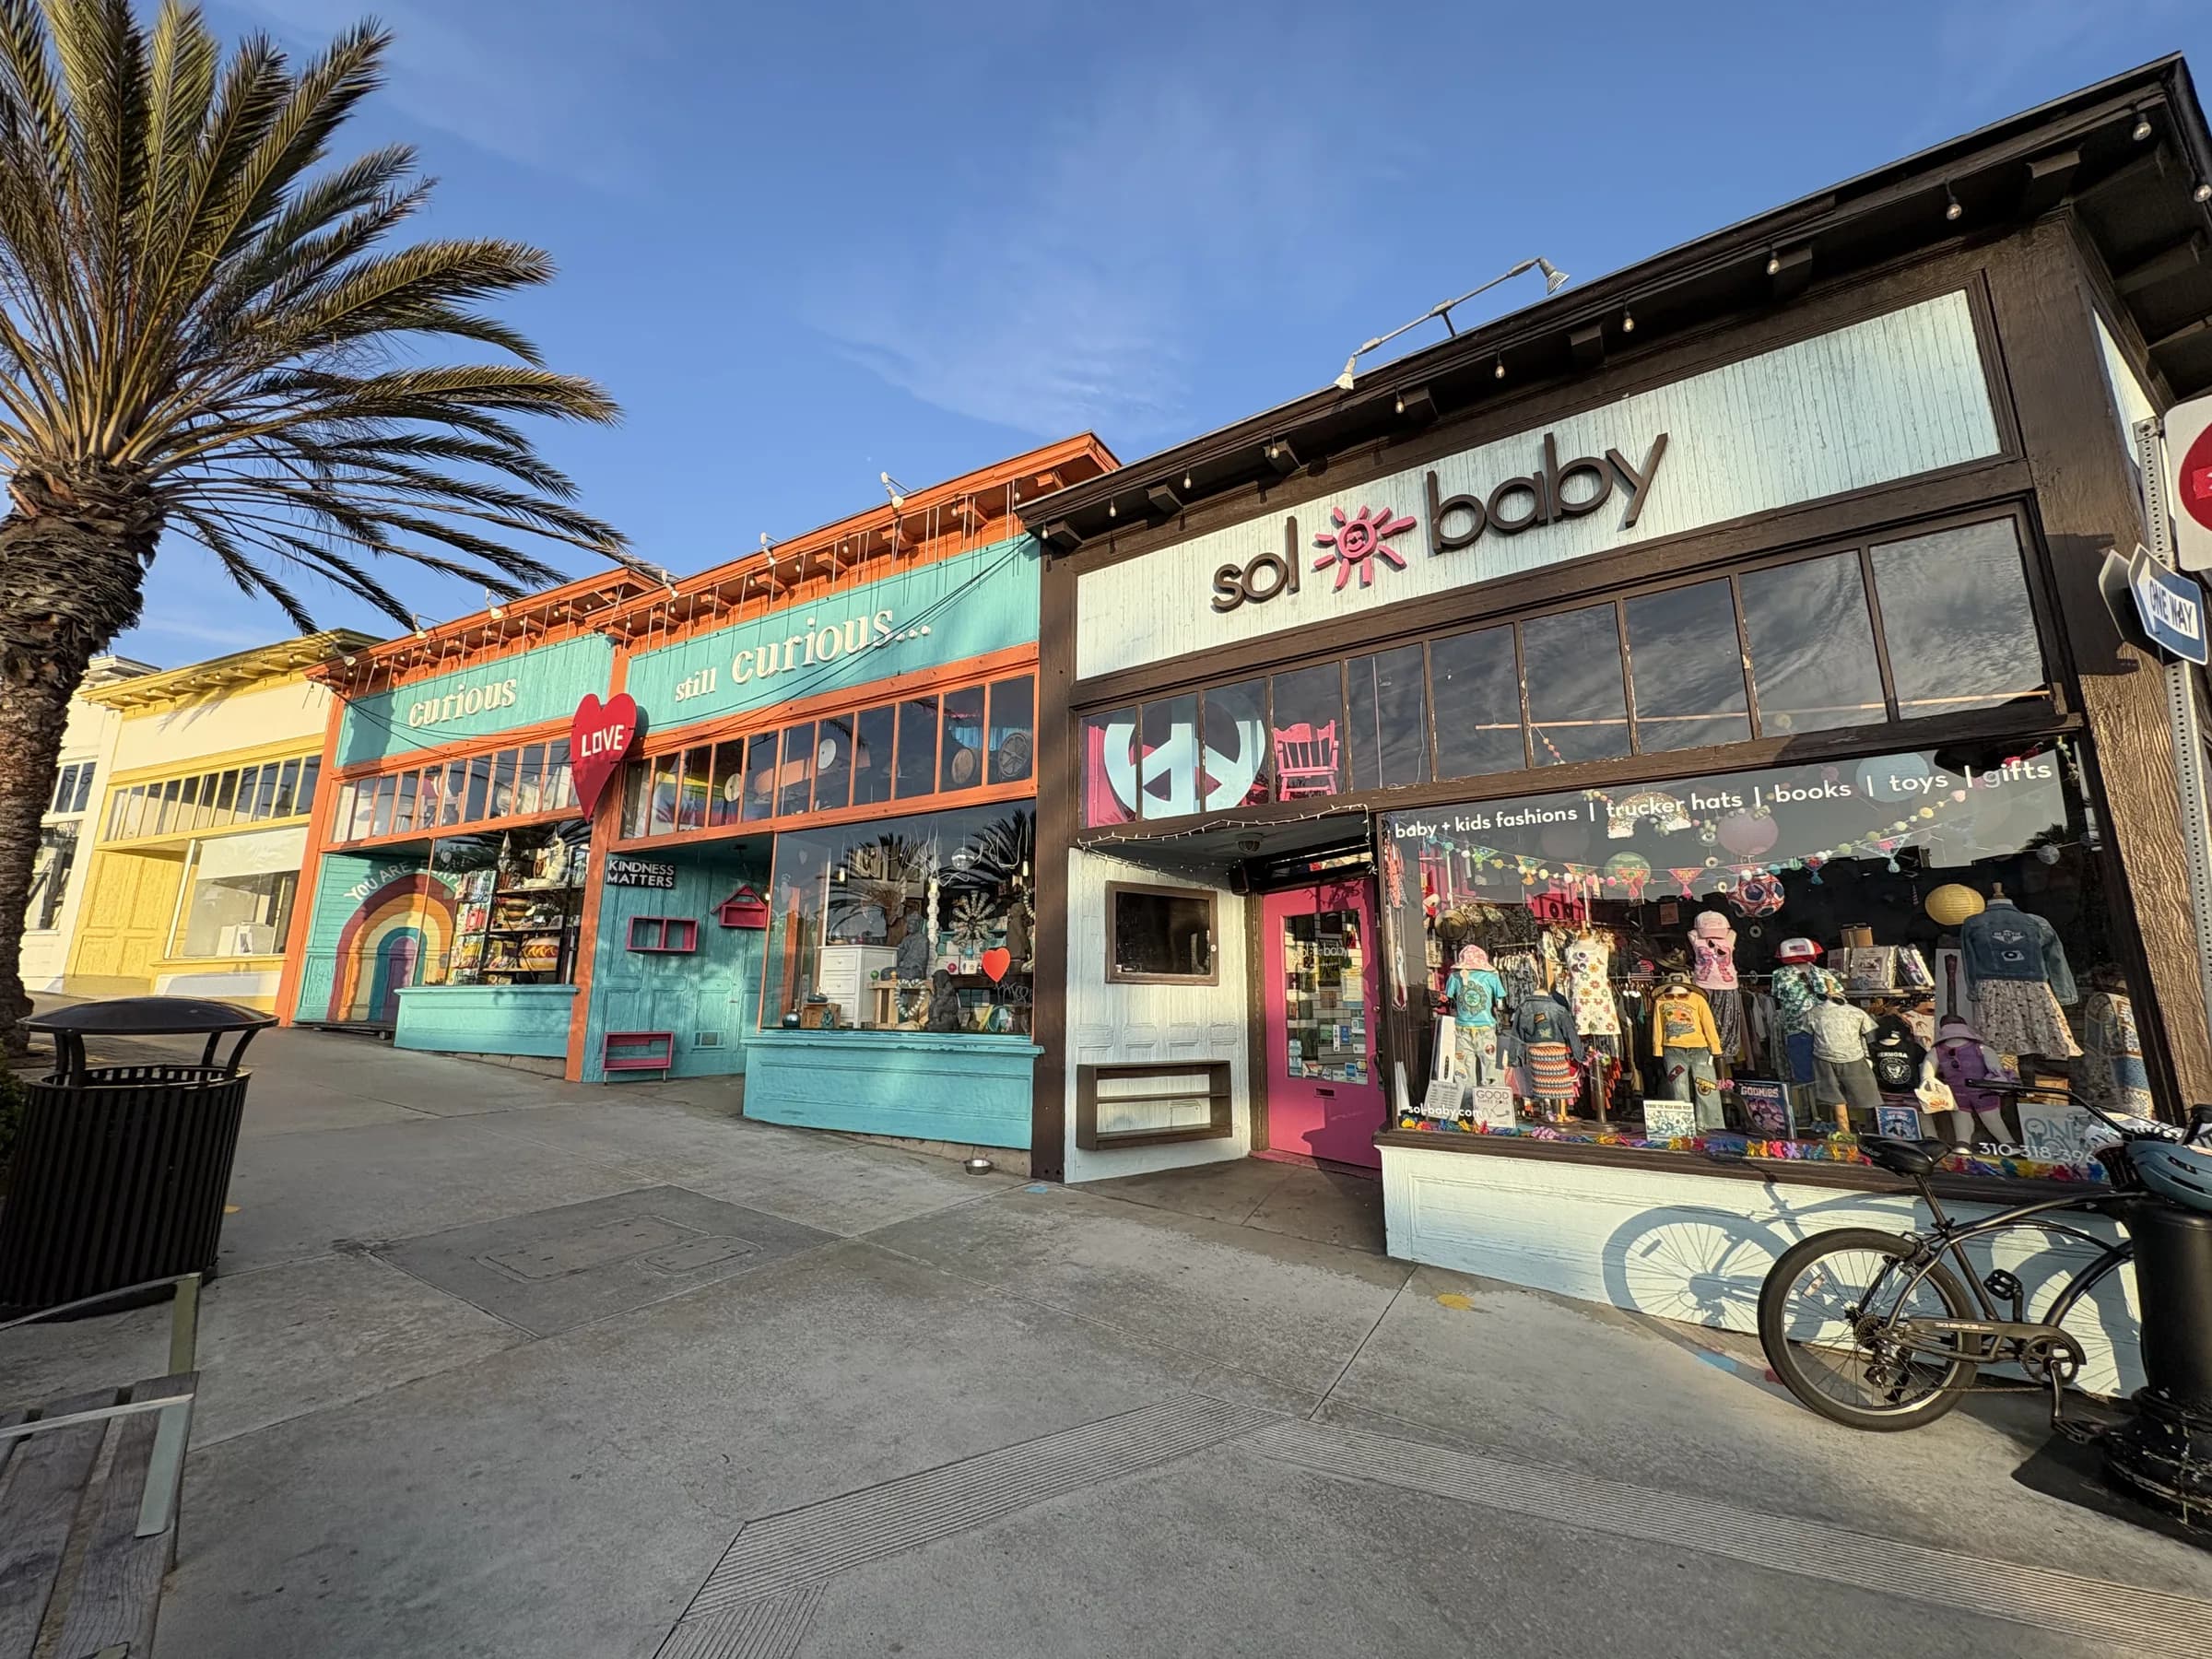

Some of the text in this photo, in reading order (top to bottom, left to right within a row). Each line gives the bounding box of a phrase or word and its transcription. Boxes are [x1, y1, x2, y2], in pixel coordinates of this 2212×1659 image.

[1211, 431, 1668, 611] sol baby
[2149, 580, 2193, 633] ONE WAY
[675, 666, 717, 702] still
[408, 678, 517, 727] curious
[581, 724, 625, 758] LOVE
[1394, 820, 1438, 839] baby
[1454, 815, 1491, 832] kids
[1495, 806, 1578, 828] fashions
[1606, 796, 1685, 818] trucker
[1690, 792, 1743, 811] hats
[1774, 780, 1851, 803] books
[1888, 773, 1949, 794] toys
[1983, 760, 2053, 788] gifts
[343, 878, 379, 901] YOU
[379, 862, 412, 882] ARE
[606, 873, 673, 888] MATTERS
[608, 860, 675, 876] KINDNESS
[1407, 1102, 1484, 1118] sol-baby.com
[1476, 1089, 1510, 1100] GOOD
[1978, 1142, 2097, 1164] 310-318-396
